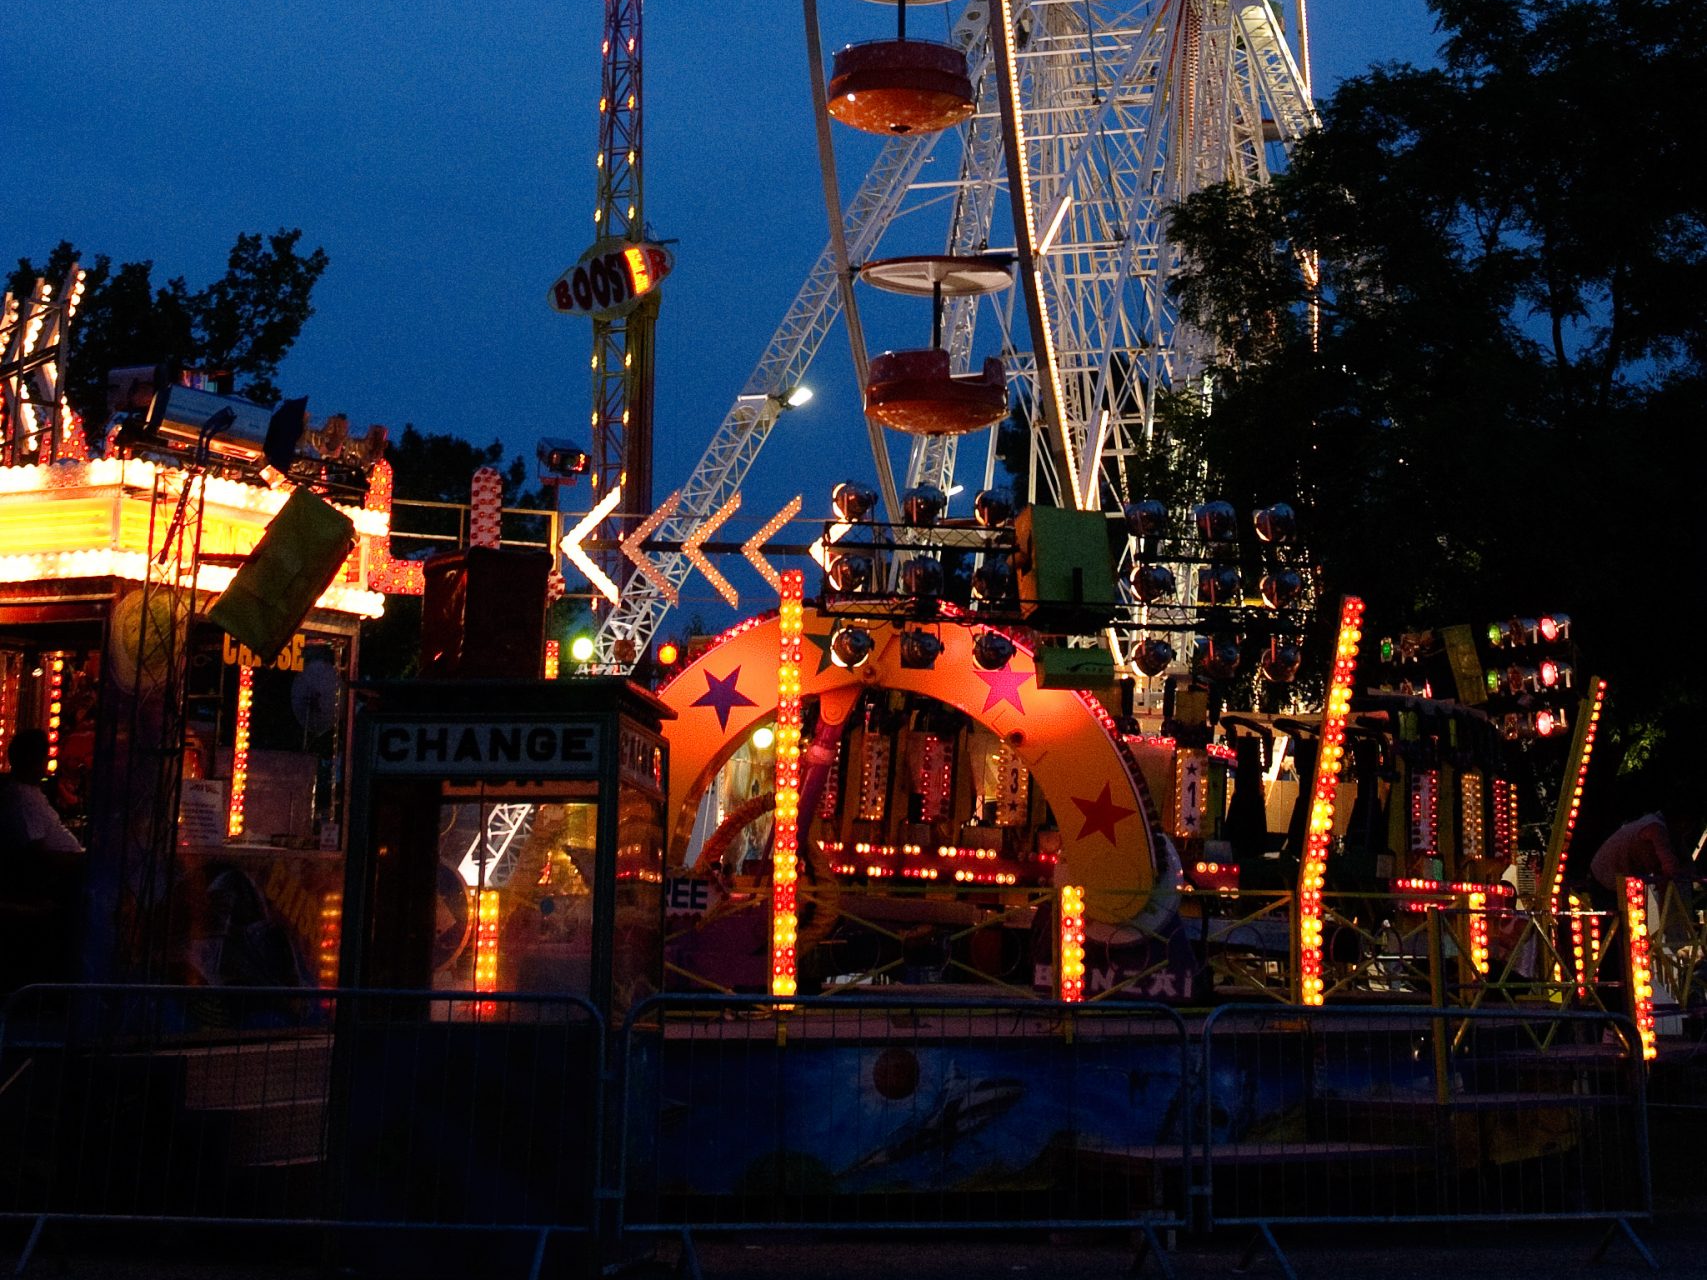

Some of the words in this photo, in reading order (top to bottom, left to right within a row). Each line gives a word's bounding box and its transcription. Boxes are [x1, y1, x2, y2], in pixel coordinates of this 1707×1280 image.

[554, 248, 671, 310] BOOSTER
[380, 728, 594, 762] CHANGE
[1011, 768, 1018, 793] 3
[1187, 781, 1196, 807] 1
[1034, 963, 1193, 998] BNZAI
